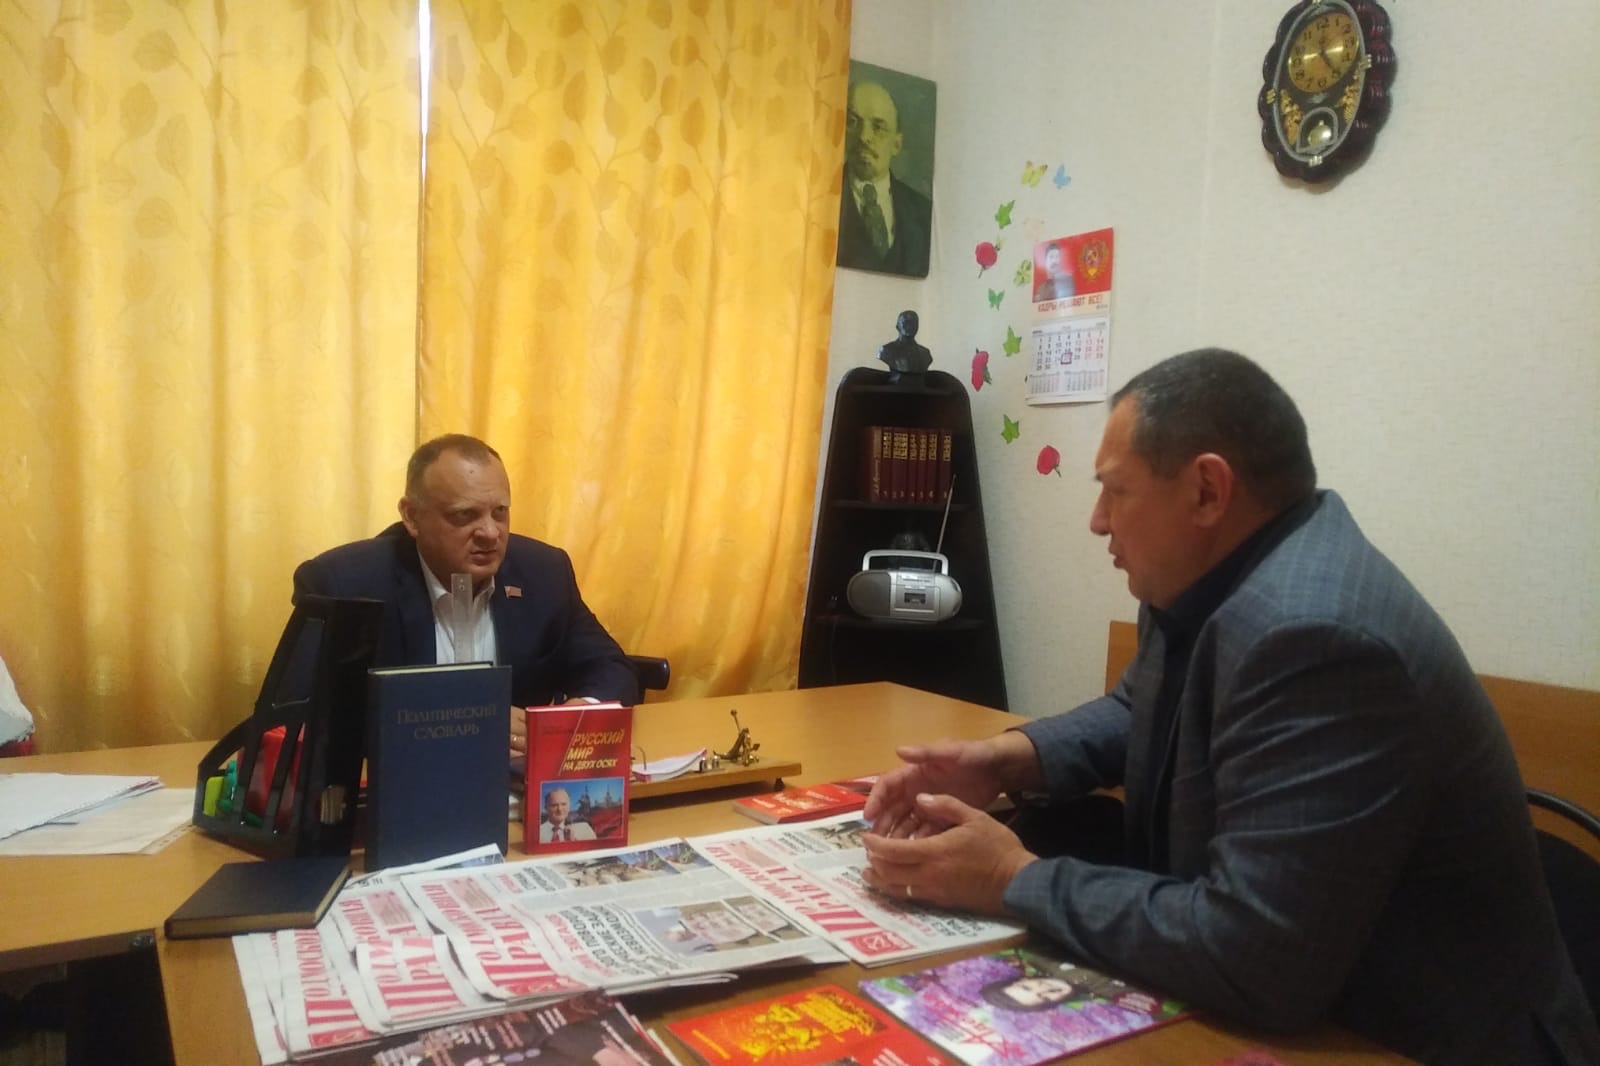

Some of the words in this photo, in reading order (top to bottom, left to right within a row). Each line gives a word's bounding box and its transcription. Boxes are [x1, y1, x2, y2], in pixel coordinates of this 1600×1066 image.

[1038, 302, 1056, 312] КАДРЫ
[397, 704, 497, 724] ПОЛИТИЧЕСКИЙ
[414, 723, 480, 740] СЛОВАРЬ
[573, 728, 625, 746] РУССКИЙ
[567, 746, 594, 760] МИР
[563, 760, 574, 771] НА
[574, 760, 596, 772] ДВУХ
[596, 758, 618, 769] ОСЯХ
